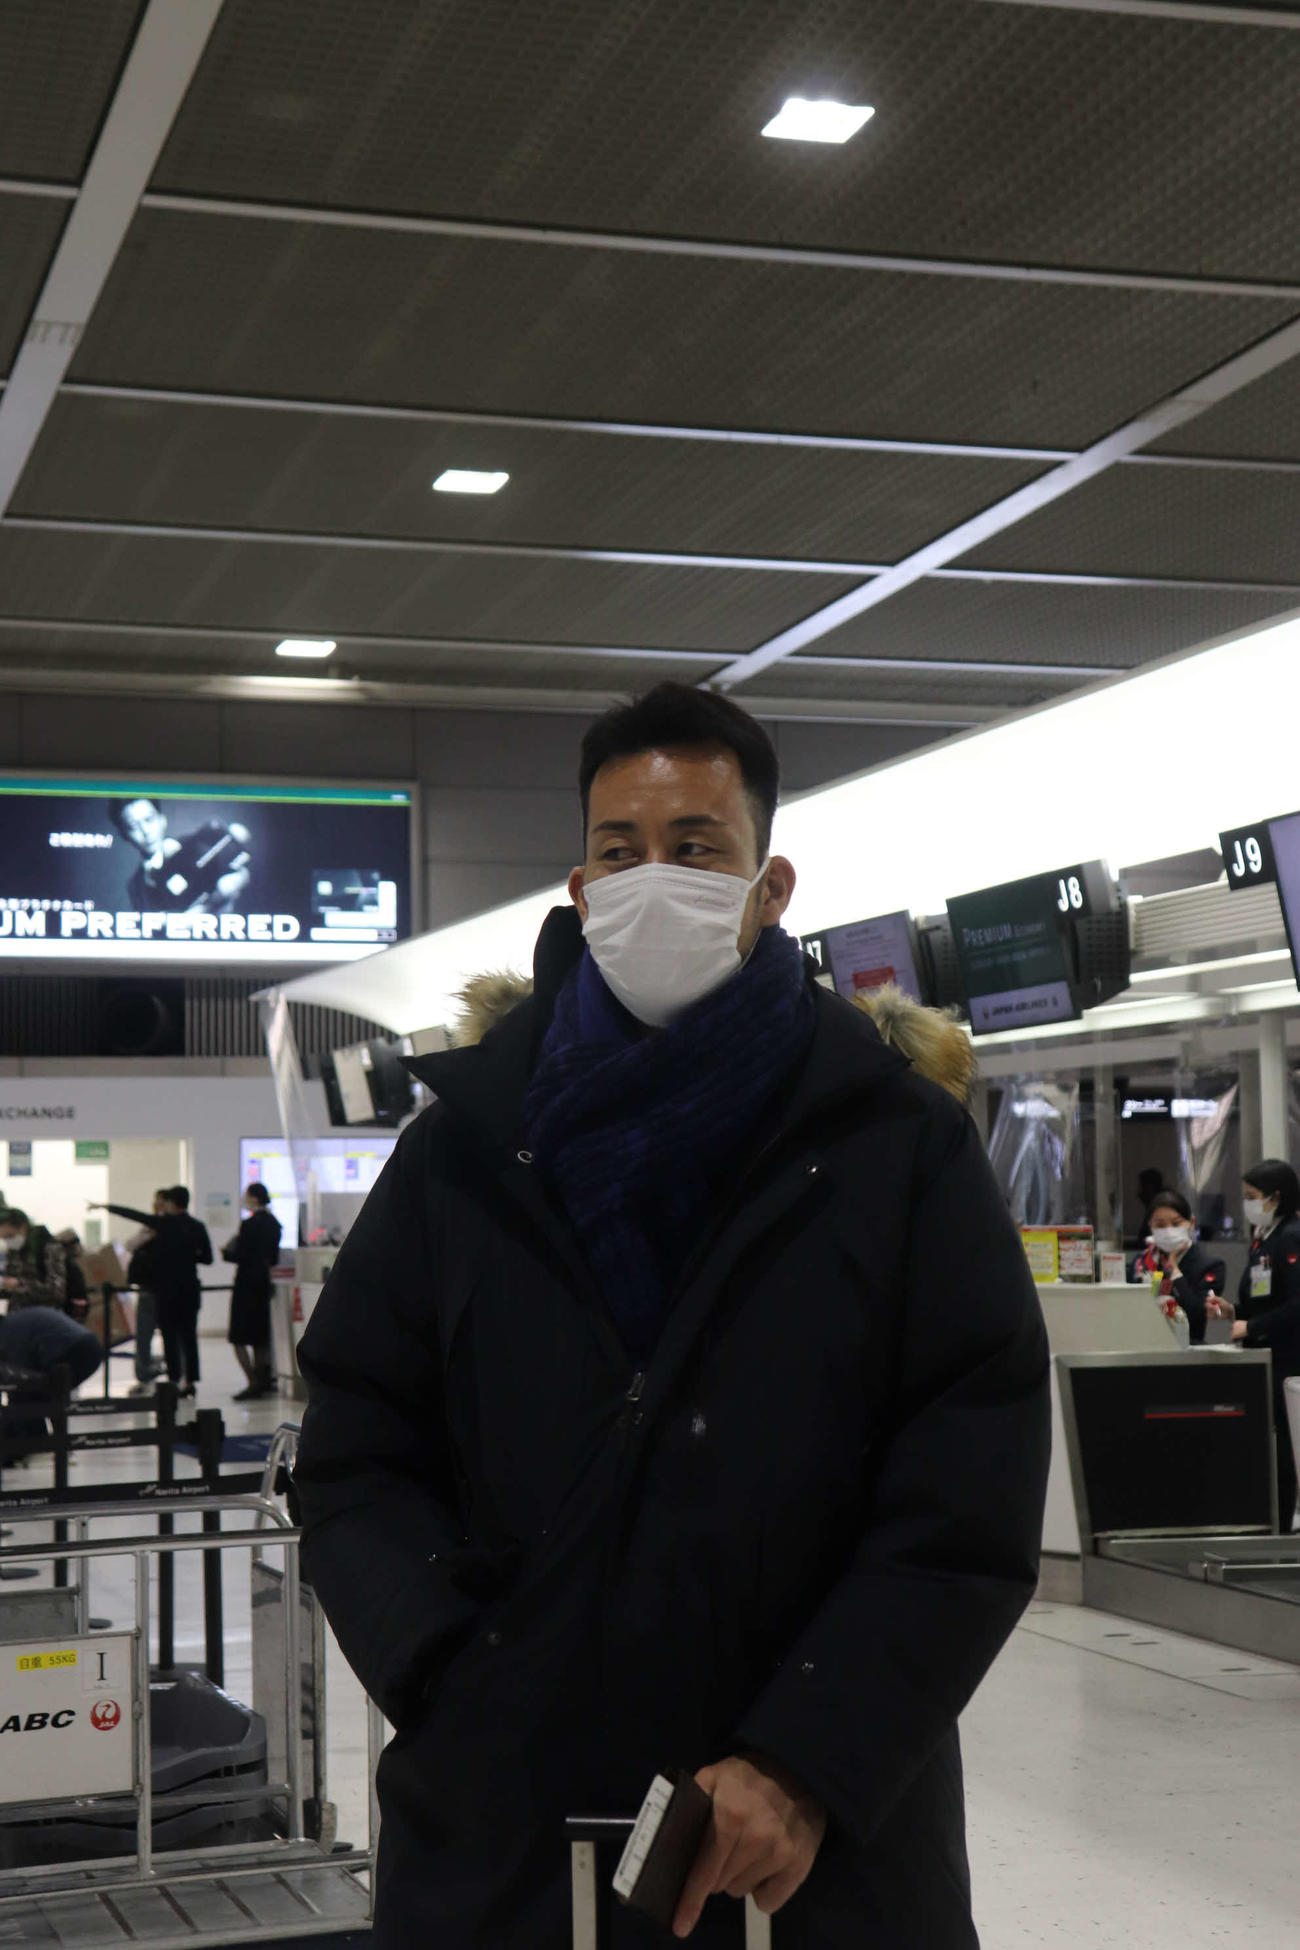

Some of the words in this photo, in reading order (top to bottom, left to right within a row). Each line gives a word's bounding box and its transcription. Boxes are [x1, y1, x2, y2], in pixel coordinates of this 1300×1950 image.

[1232, 837, 1263, 877] J9
[1057, 876, 1083, 912] J8
[60, 910, 300, 941] PREFERRED
[0, 1106, 75, 1119] CHANGE
[154, 1487, 180, 1497] Narita
[181, 1484, 210, 1496] Airport
[49, 1654, 77, 1666] 55KG
[0, 1709, 76, 1733] ABC
